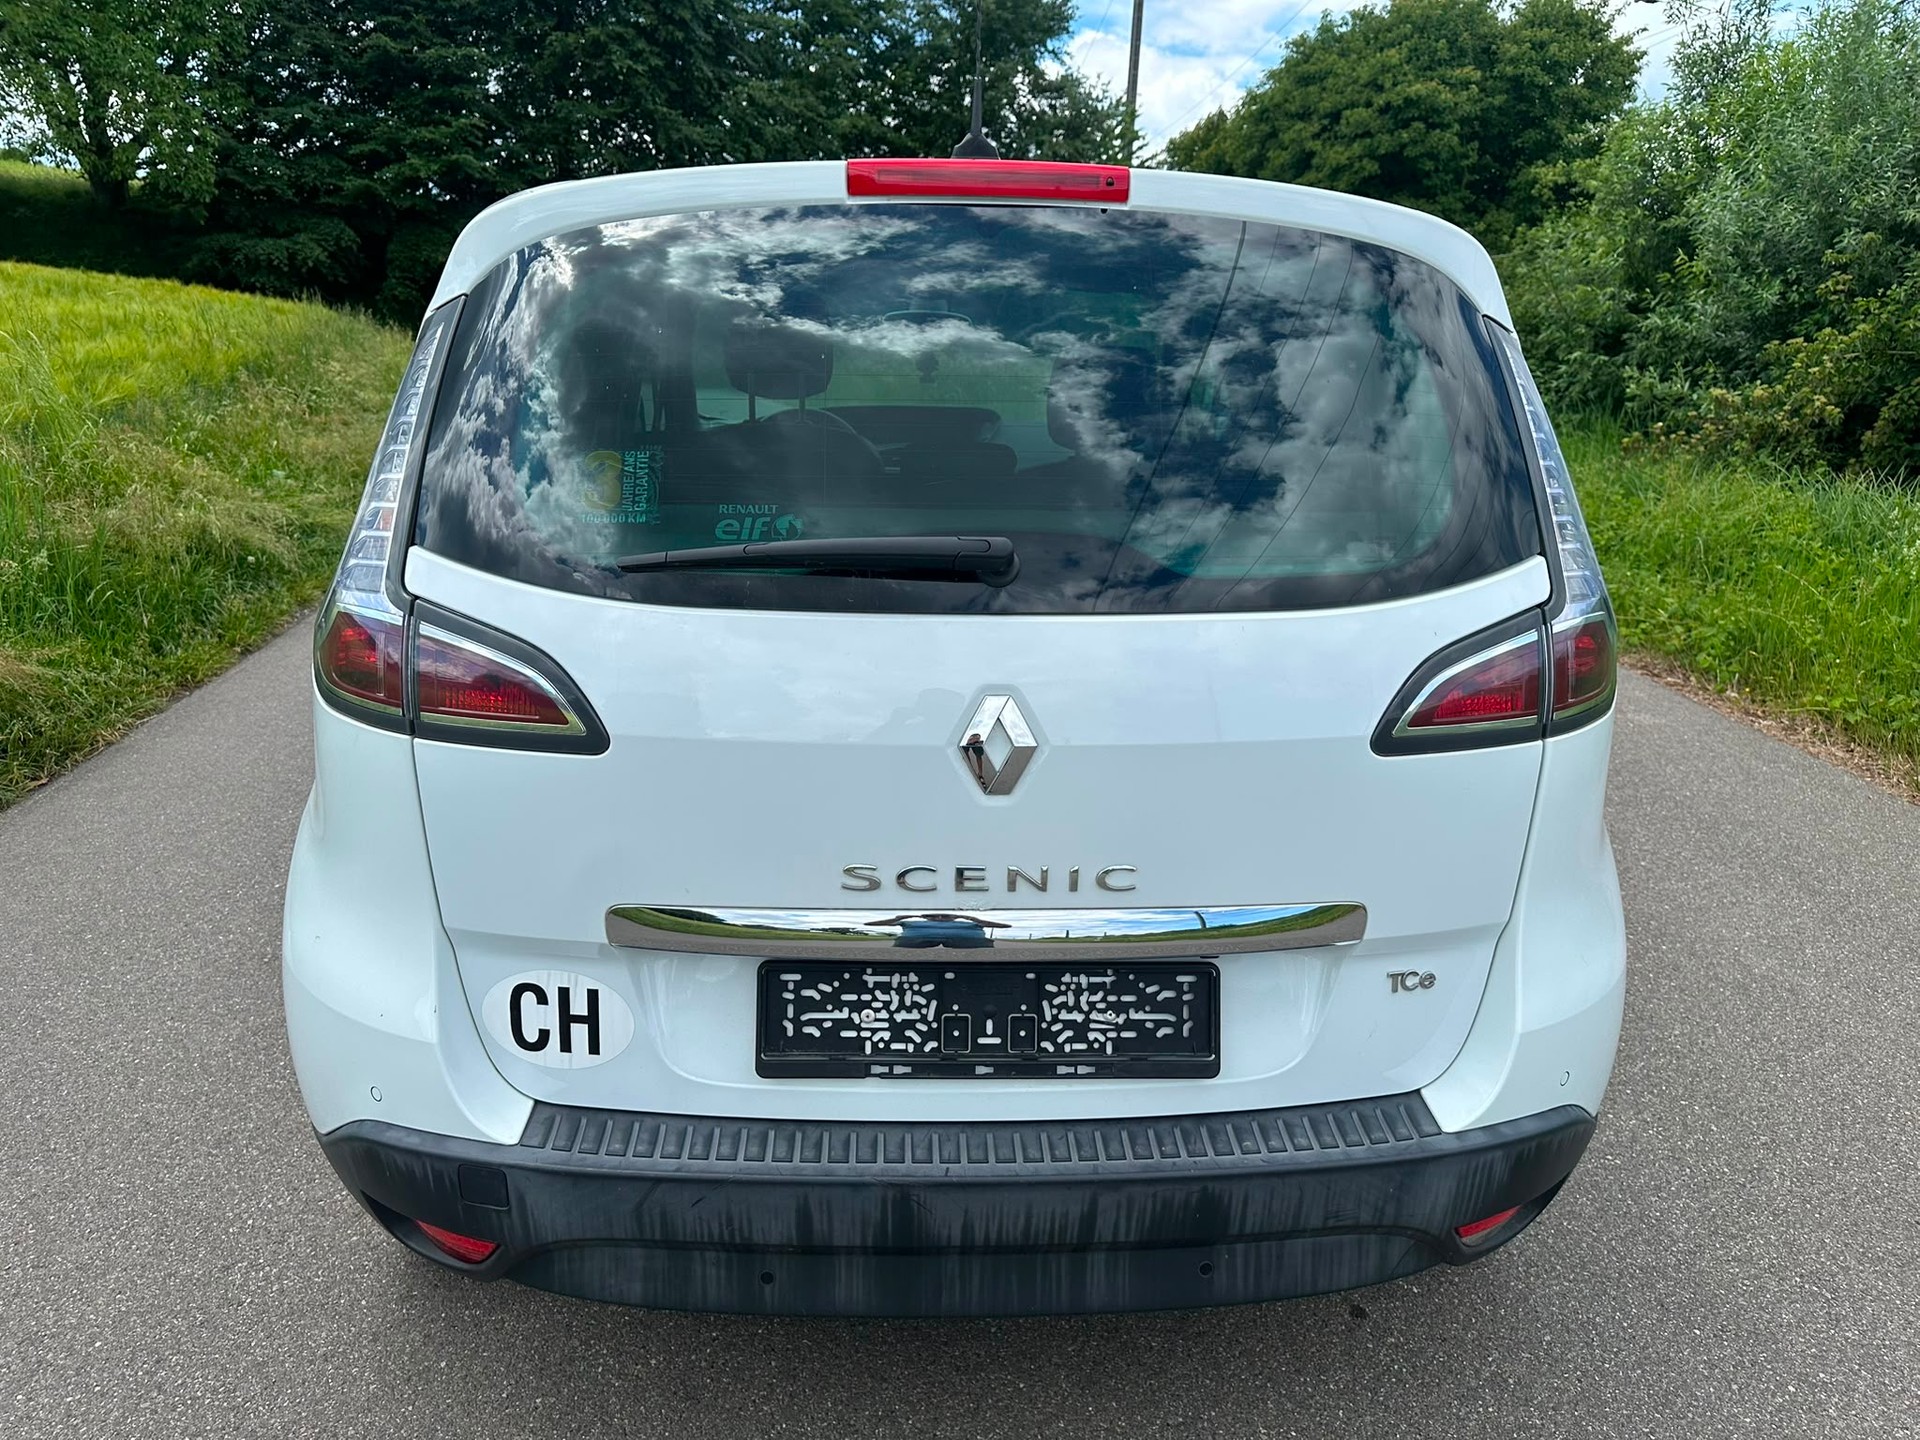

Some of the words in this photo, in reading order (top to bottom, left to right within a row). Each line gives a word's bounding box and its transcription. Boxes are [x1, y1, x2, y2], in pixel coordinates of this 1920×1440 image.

[621, 450, 636, 511] JAHRE/ANS
[634, 450, 650, 511] GARANTIE
[628, 513, 646, 524] KM
[719, 504, 779, 514] RENAULT
[715, 516, 771, 540] elf
[840, 864, 1138, 892] SCENIC
[1386, 969, 1437, 993] TCe
[509, 982, 601, 1056] CH
